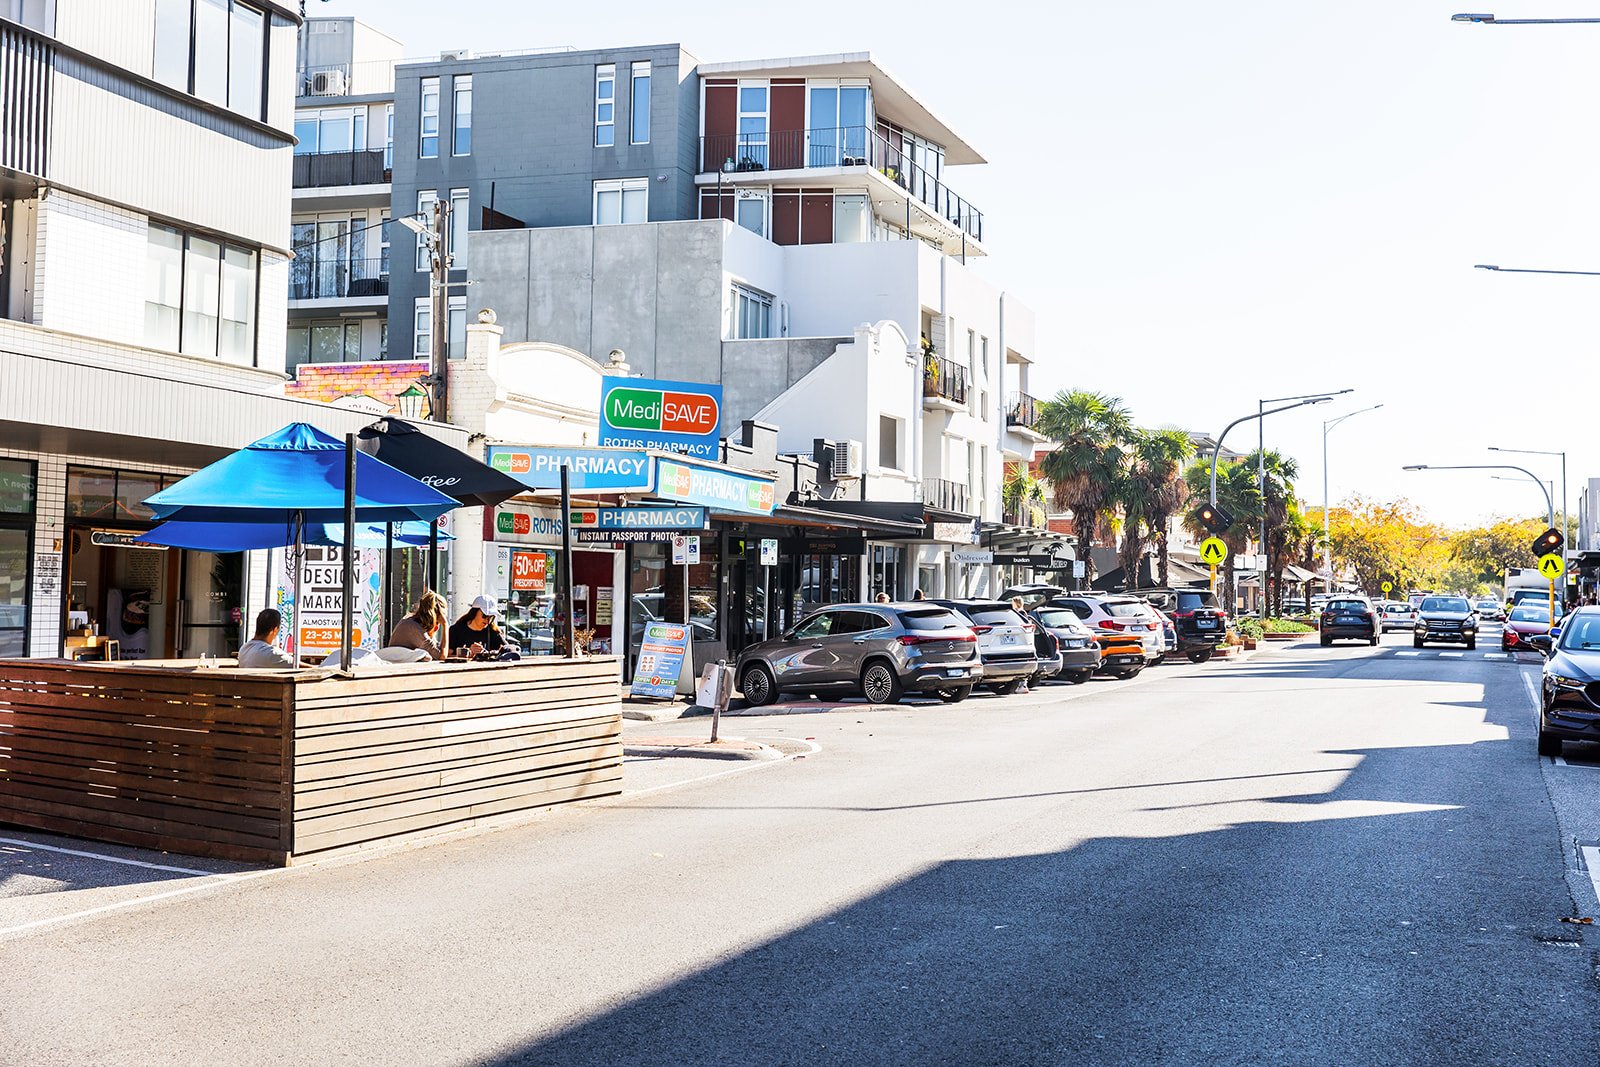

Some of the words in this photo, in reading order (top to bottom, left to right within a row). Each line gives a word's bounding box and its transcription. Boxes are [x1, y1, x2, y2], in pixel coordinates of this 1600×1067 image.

[613, 398, 711, 424] MediSAVE
[604, 438, 644, 448] ROTHS
[646, 441, 712, 455] PHARMACY
[535, 455, 646, 476] PHARMACY
[691, 474, 746, 501] PHARMACY
[602, 511, 699, 525] PHARMACY
[533, 517, 563, 535] ROTHS
[580, 531, 609, 541] INSTANT
[611, 531, 648, 541] PASSPORT
[650, 531, 680, 541] PHOTOS
[498, 551, 508, 559] DSS
[515, 555, 533, 576] 50%
[533, 559, 545, 573] OFF
[514, 578, 544, 587] PRESCRIPTIONS
[302, 595, 360, 609] MARKT
[653, 677, 659, 685] 7
